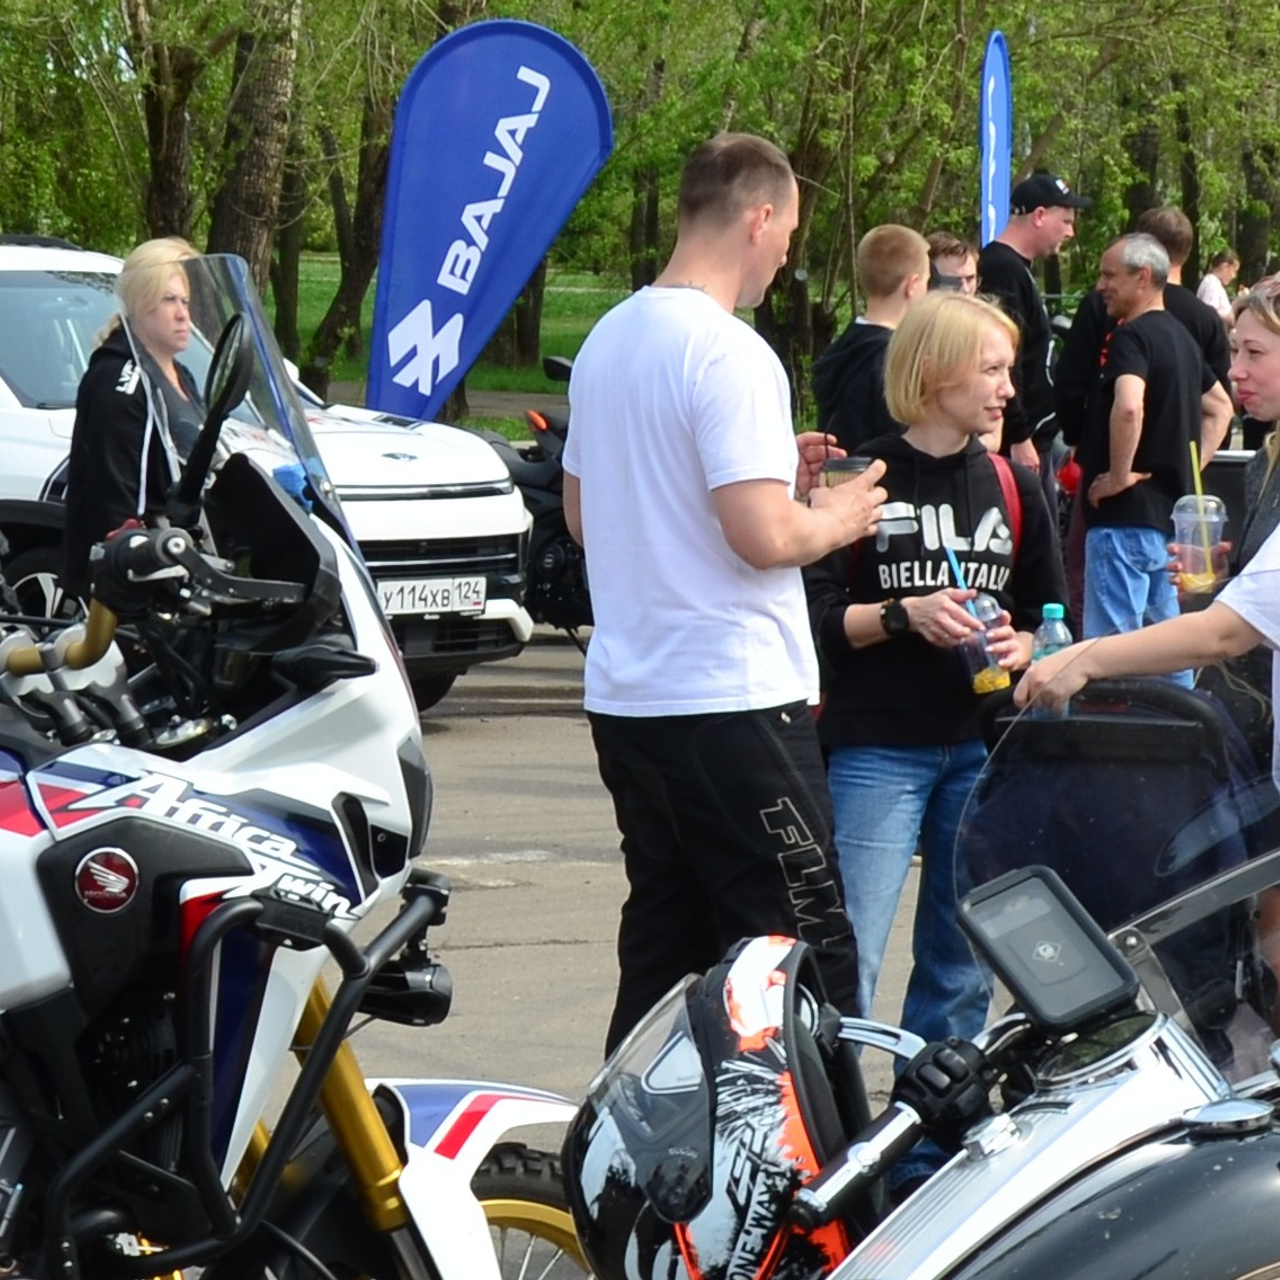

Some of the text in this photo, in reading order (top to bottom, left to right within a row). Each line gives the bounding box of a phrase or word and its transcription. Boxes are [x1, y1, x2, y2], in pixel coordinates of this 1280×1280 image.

[437, 65, 551, 295] BAJAJ
[876, 502, 1014, 556] FILA
[455, 580, 482, 600] 124
[878, 560, 951, 589] BIELLA
[68, 770, 320, 872] Africa
